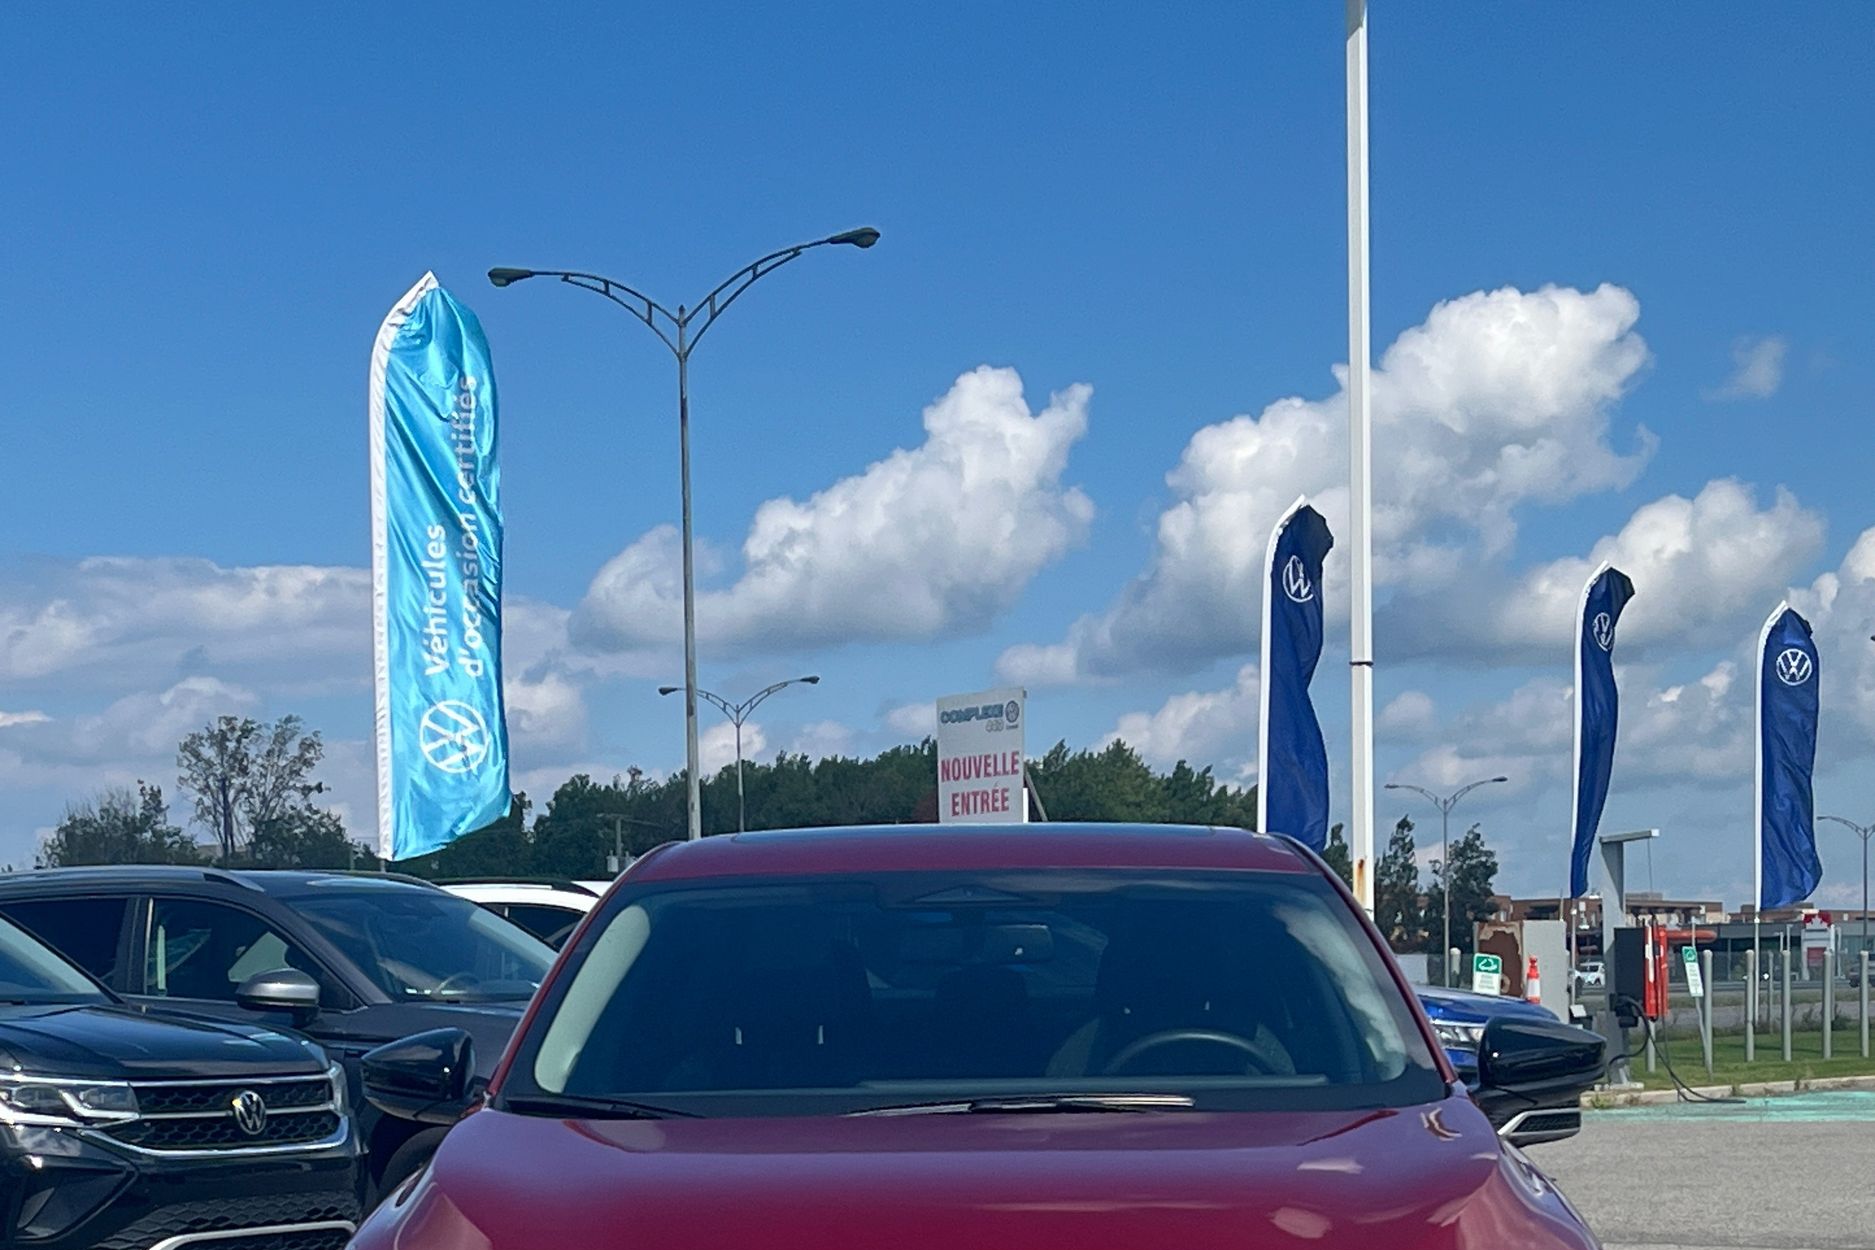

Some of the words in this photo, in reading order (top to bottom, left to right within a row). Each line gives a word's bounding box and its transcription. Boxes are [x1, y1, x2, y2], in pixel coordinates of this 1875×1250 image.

[450, 374, 477, 506] certifiés
[422, 523, 450, 678] Véhicules
[454, 513, 485, 678] d'occasion
[940, 750, 1020, 783] NOUVELLE
[951, 783, 1010, 817] ENTRÉE
